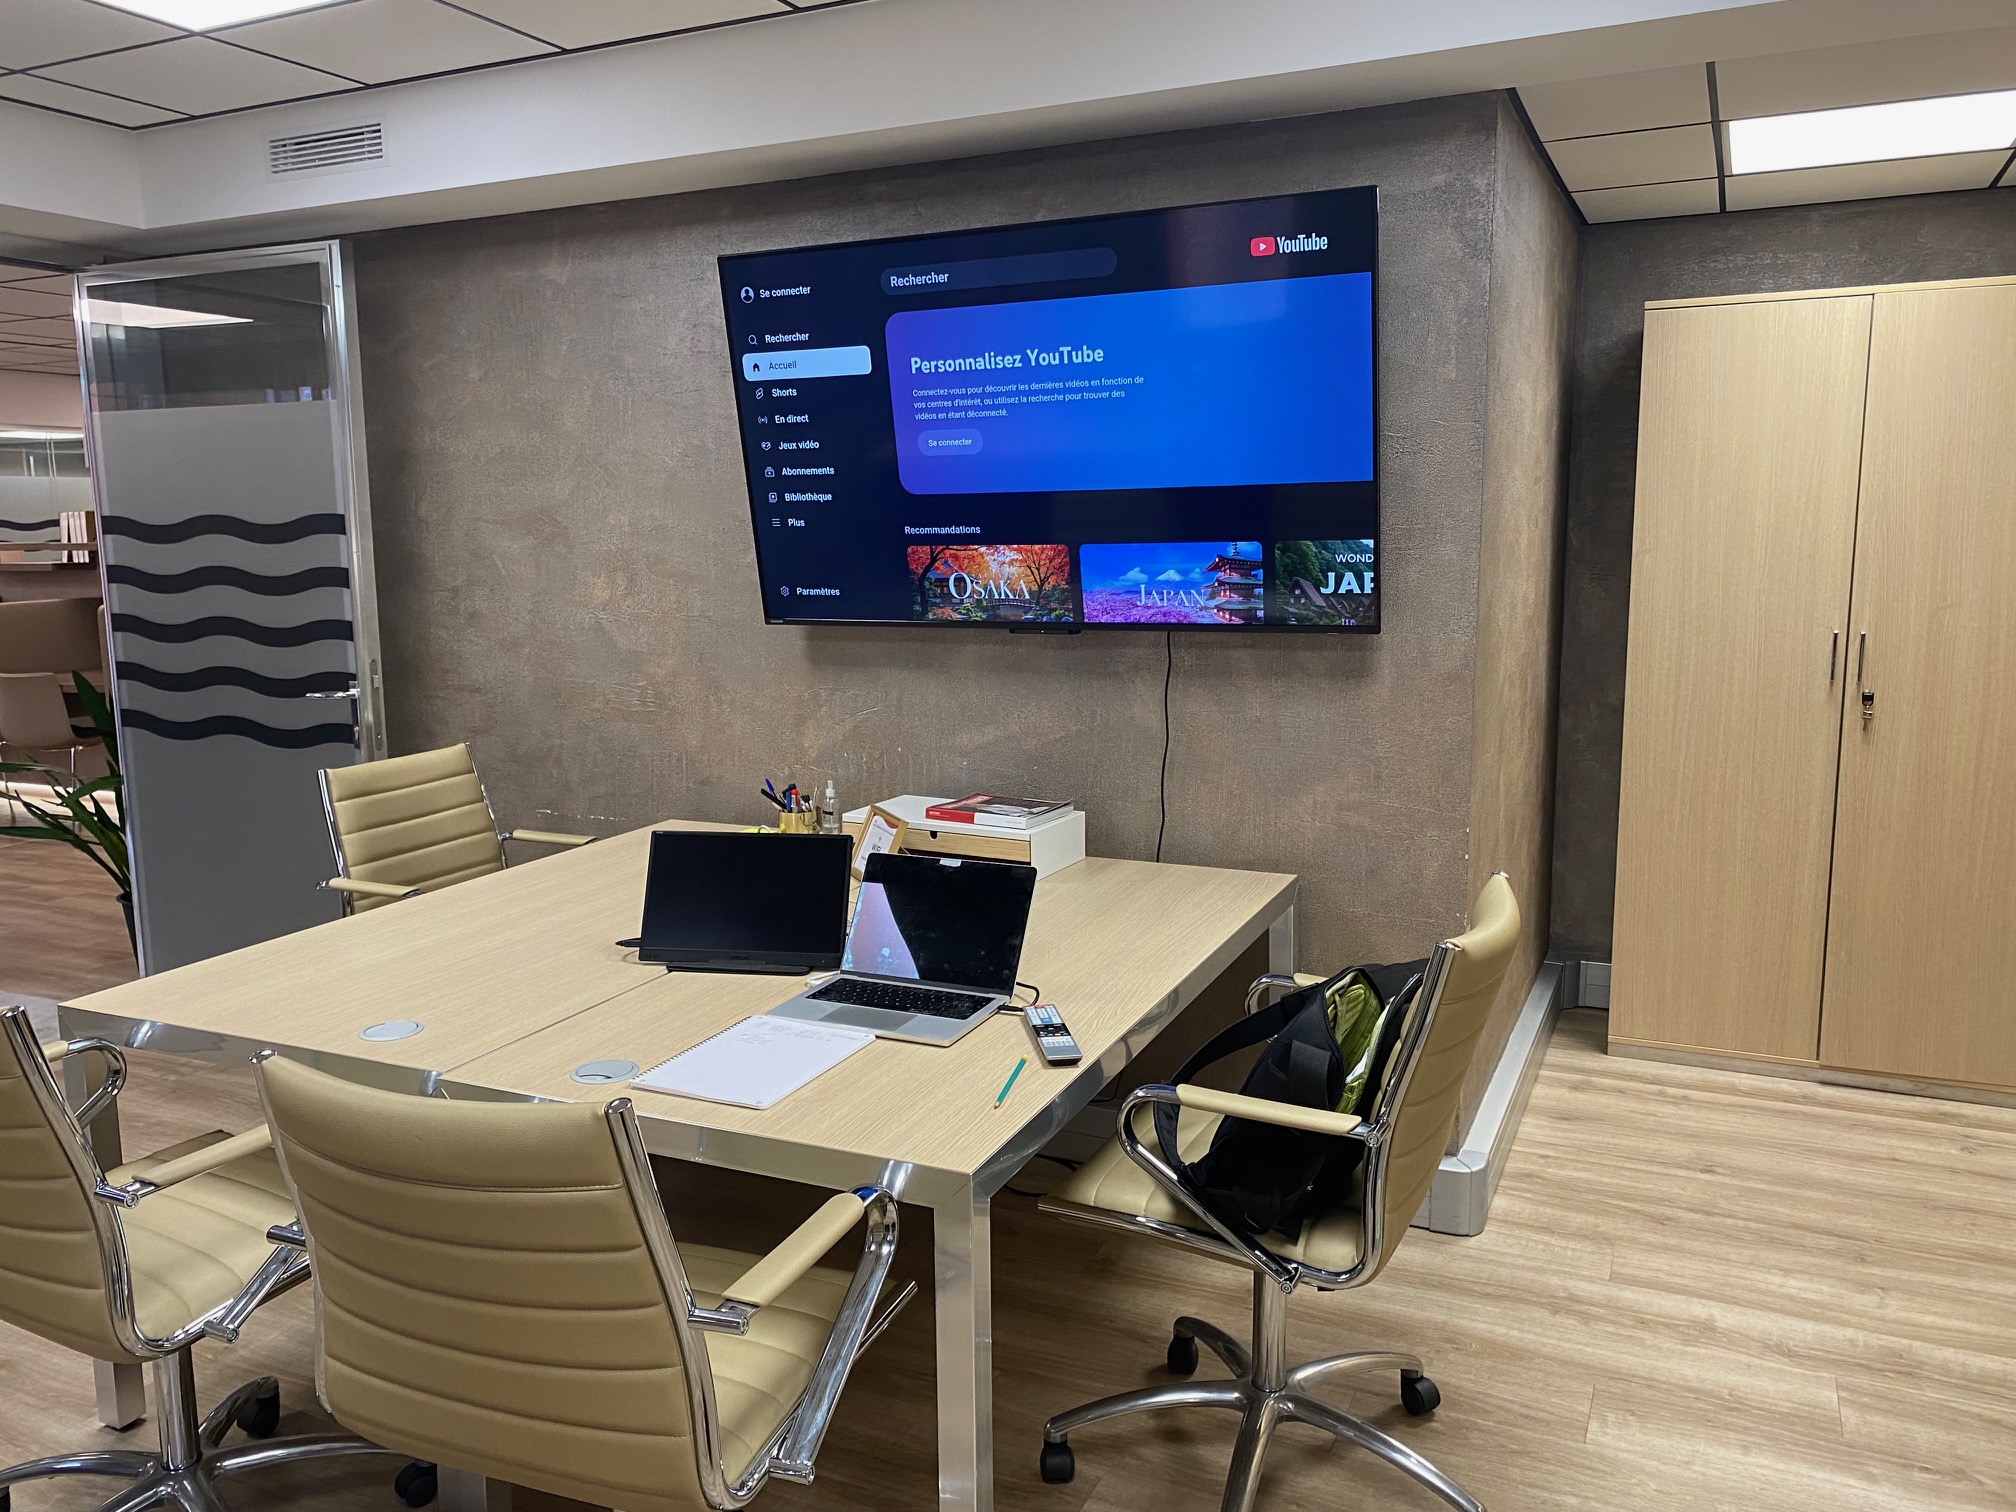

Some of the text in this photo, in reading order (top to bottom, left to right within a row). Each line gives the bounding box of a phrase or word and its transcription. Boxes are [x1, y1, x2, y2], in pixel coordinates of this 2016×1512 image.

[1276, 232, 1328, 254] YouTube
[890, 271, 949, 287] Rechercher
[759, 285, 811, 298] Se connecter
[764, 332, 810, 343] Rechercher
[768, 360, 797, 370] Accueil
[910, 345, 1104, 374] Personnalisez YouTube
[912, 375, 1144, 397] Connectez-vous pour découvrir les dernières vidéos en fonction de
[771, 388, 798, 397] Shorts
[926, 400, 953, 408] centres
[953, 397, 983, 407] d'intérêt,
[993, 396, 1019, 404] utilisez
[1020, 395, 1027, 403] la
[1028, 393, 1064, 403] recherche
[1065, 393, 1082, 402] pour
[1083, 390, 1110, 399] trouver
[1110, 389, 1125, 398] des
[774, 414, 809, 424] En direct
[914, 412, 937, 420] vidéos
[947, 410, 966, 419] étant
[966, 408, 1009, 418] déconnecté.
[778, 440, 820, 450] Jeux vidéo
[927, 437, 973, 447] Se connecter
[781, 466, 835, 476] Abonnements
[784, 492, 833, 503] Bibliothèque
[787, 518, 806, 527] Plus
[904, 525, 981, 535] Recommandations
[796, 586, 841, 596] Paramètres
[948, 572, 1031, 599] OSAKA
[1136, 584, 1204, 607] JAPAN
